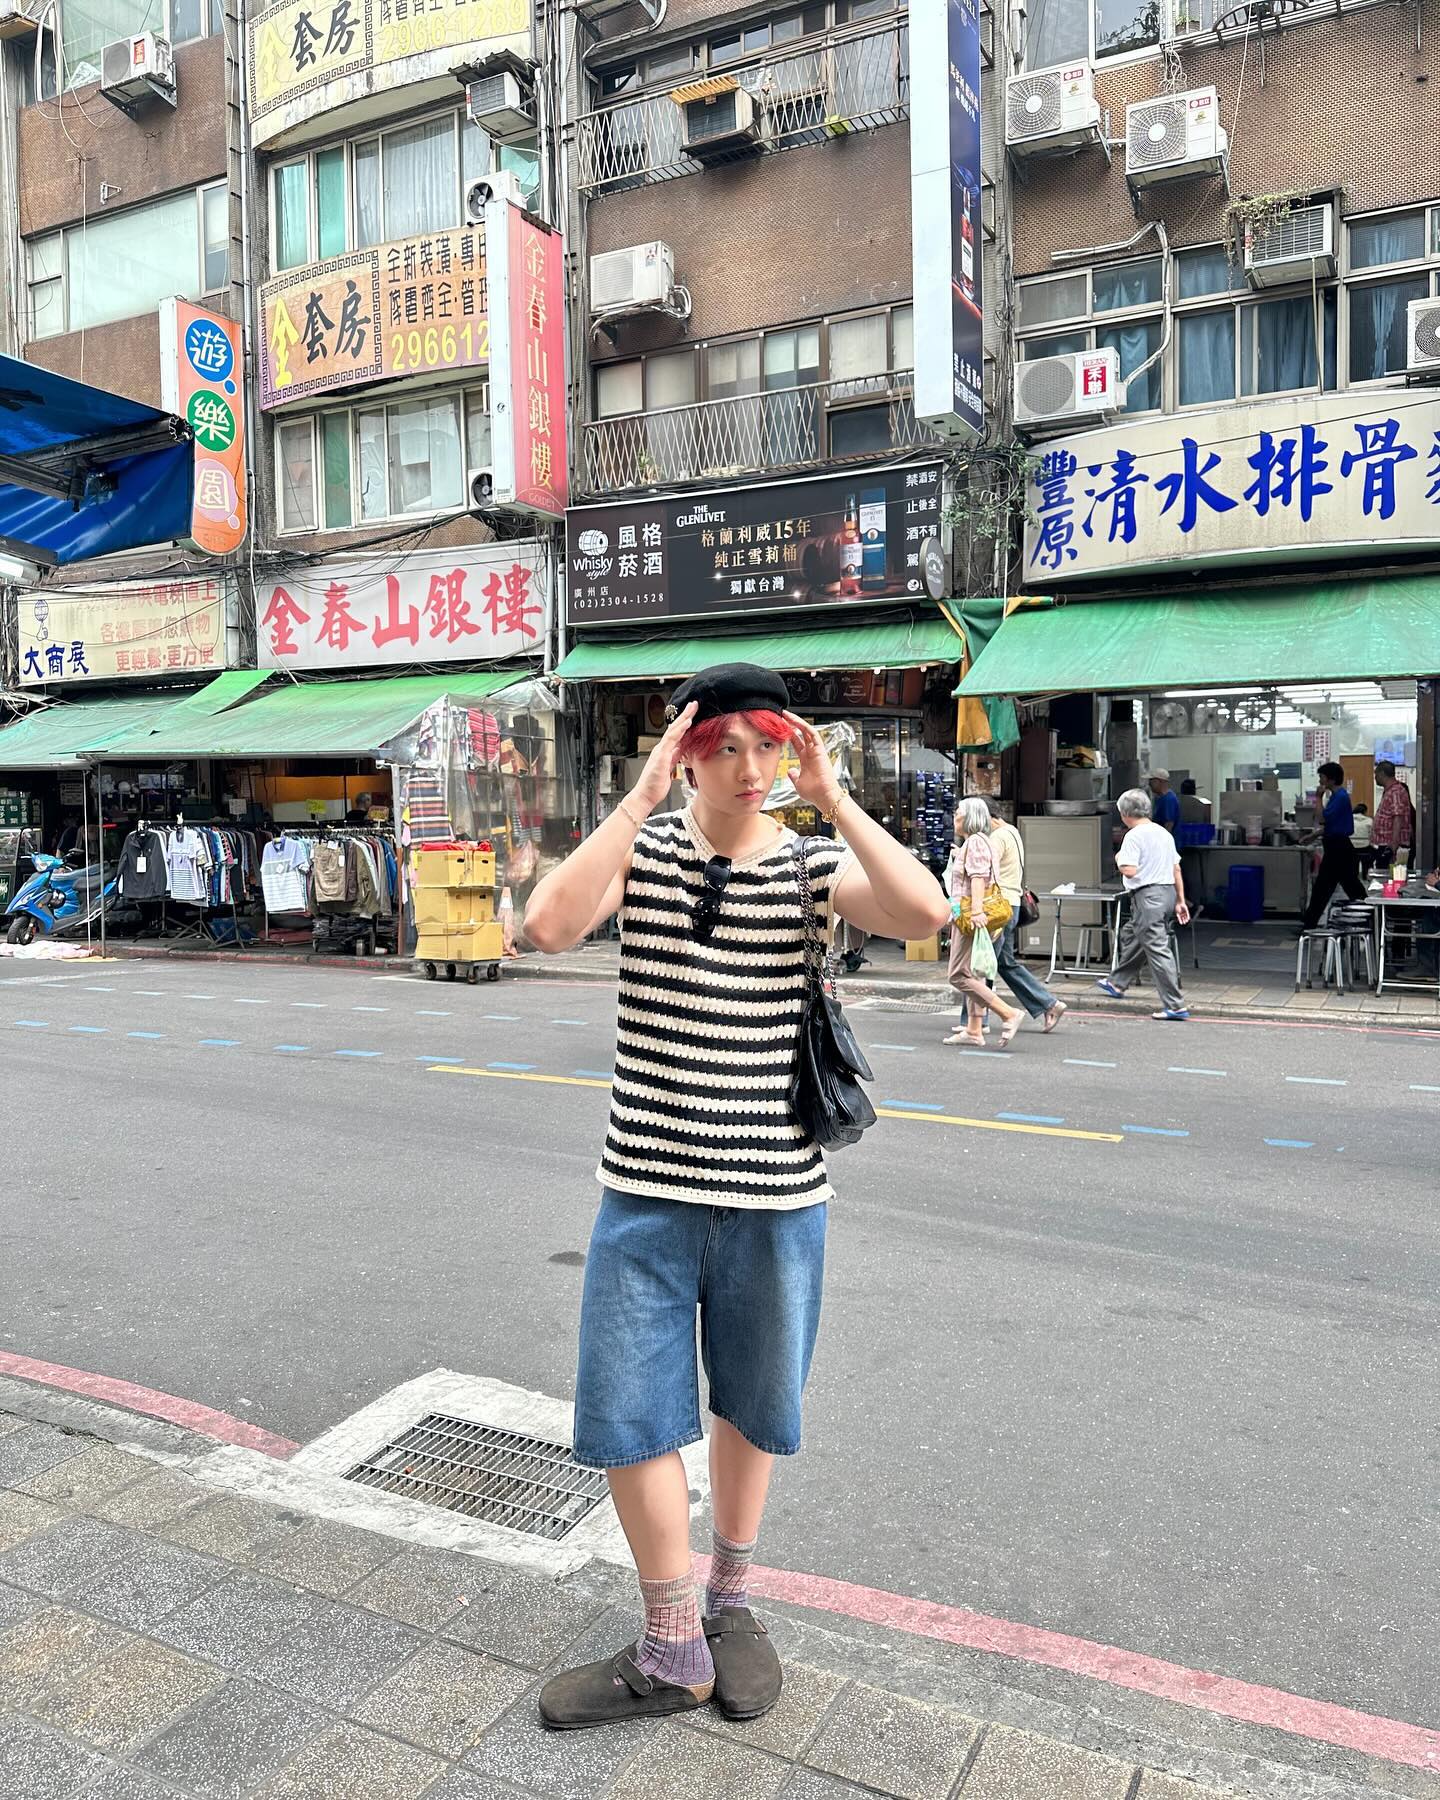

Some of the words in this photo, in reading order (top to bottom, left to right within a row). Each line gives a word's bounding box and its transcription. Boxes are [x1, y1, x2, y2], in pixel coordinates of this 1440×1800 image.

[270, 280, 371, 388] 金套房
[523, 231, 553, 491] 金春山銀樓
[189, 327, 232, 513] 遊樂園
[1082, 418, 1440, 543] 清水排骨
[676, 511, 726, 527] GLENLIVET
[693, 505, 708, 514] THE
[906, 473, 919, 568] 禁止酒駕
[1030, 449, 1078, 571] 豐原
[618, 522, 662, 549] 風格
[701, 519, 812, 547] 格蘭利威15年
[573, 556, 613, 571] Whisky
[618, 552, 662, 578] 菸酒
[714, 544, 797, 568] 純正雪莉桶
[586, 569, 609, 580] style
[730, 575, 785, 595] 獨獻台灣
[262, 564, 543, 655] 金春山銀樓
[574, 593, 664, 609] (02)2304-1528
[23, 641, 90, 678] 大商展
